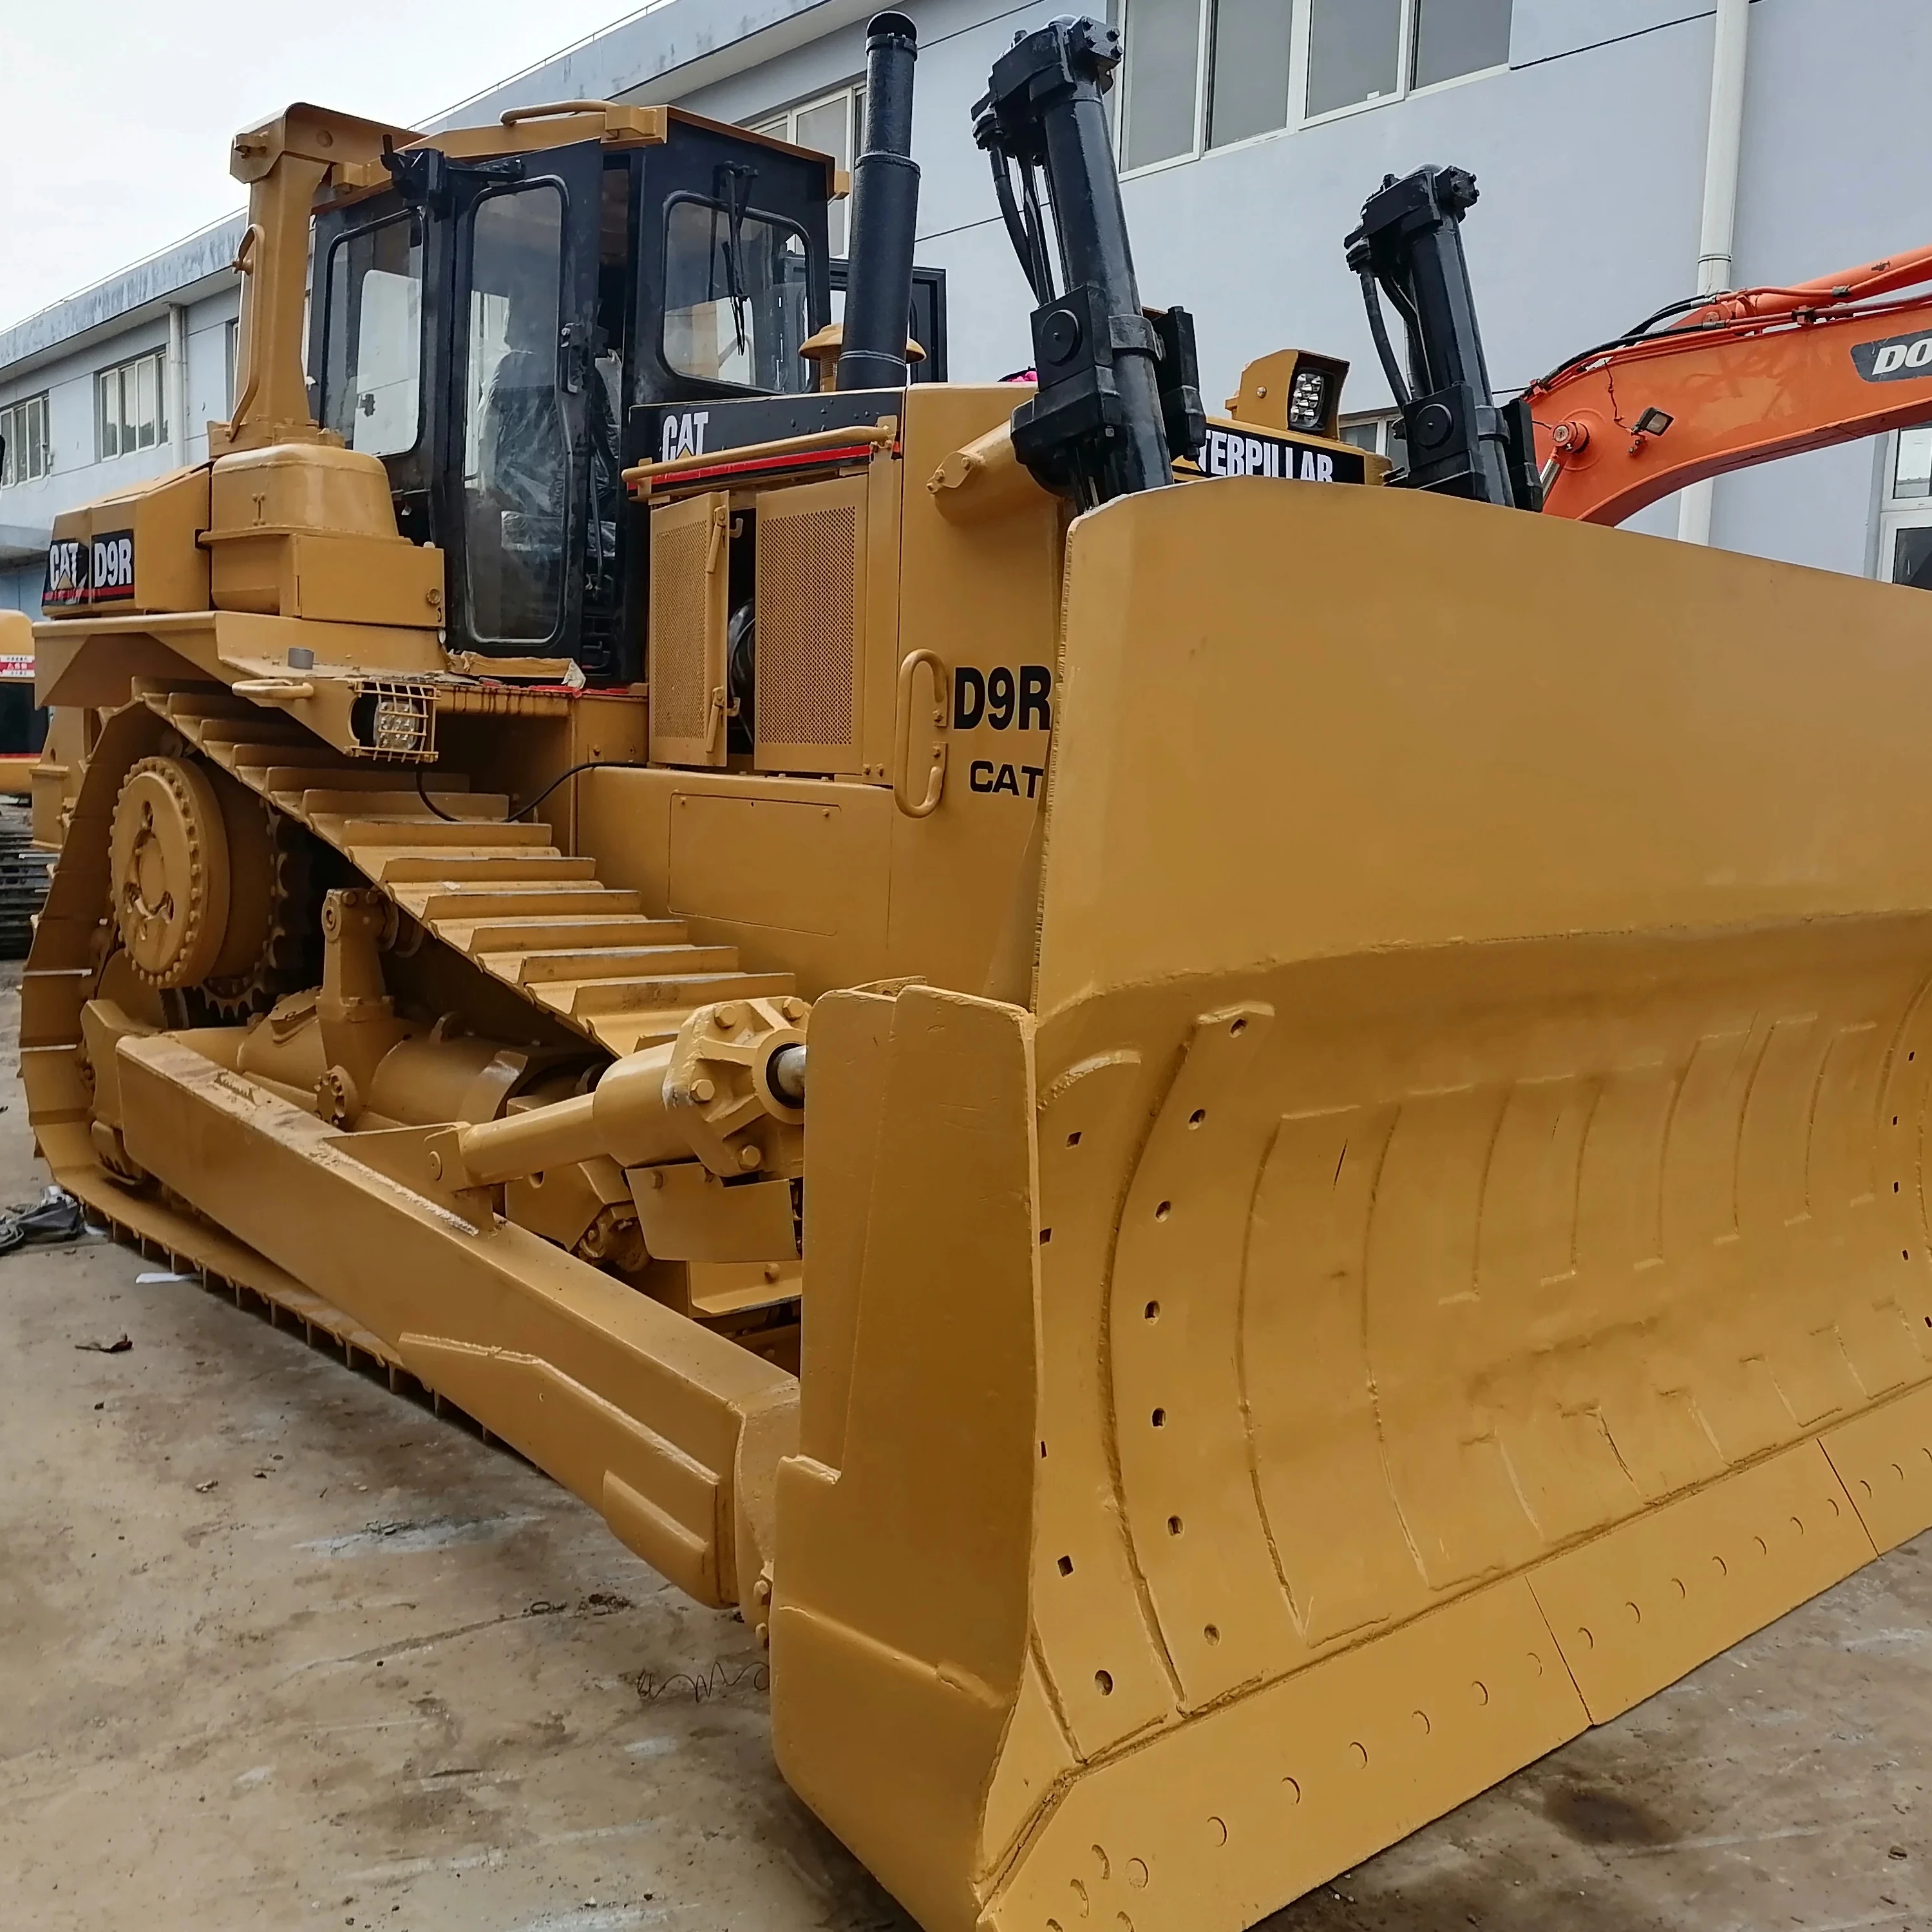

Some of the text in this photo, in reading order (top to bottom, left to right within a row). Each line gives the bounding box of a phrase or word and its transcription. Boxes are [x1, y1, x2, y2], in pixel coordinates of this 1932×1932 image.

[1872, 337, 1932, 375] DO
[662, 412, 709, 463] CAT
[50, 538, 132, 591] CAT D9R
[953, 665, 1052, 730] D9R
[970, 761, 1044, 798] CAT
